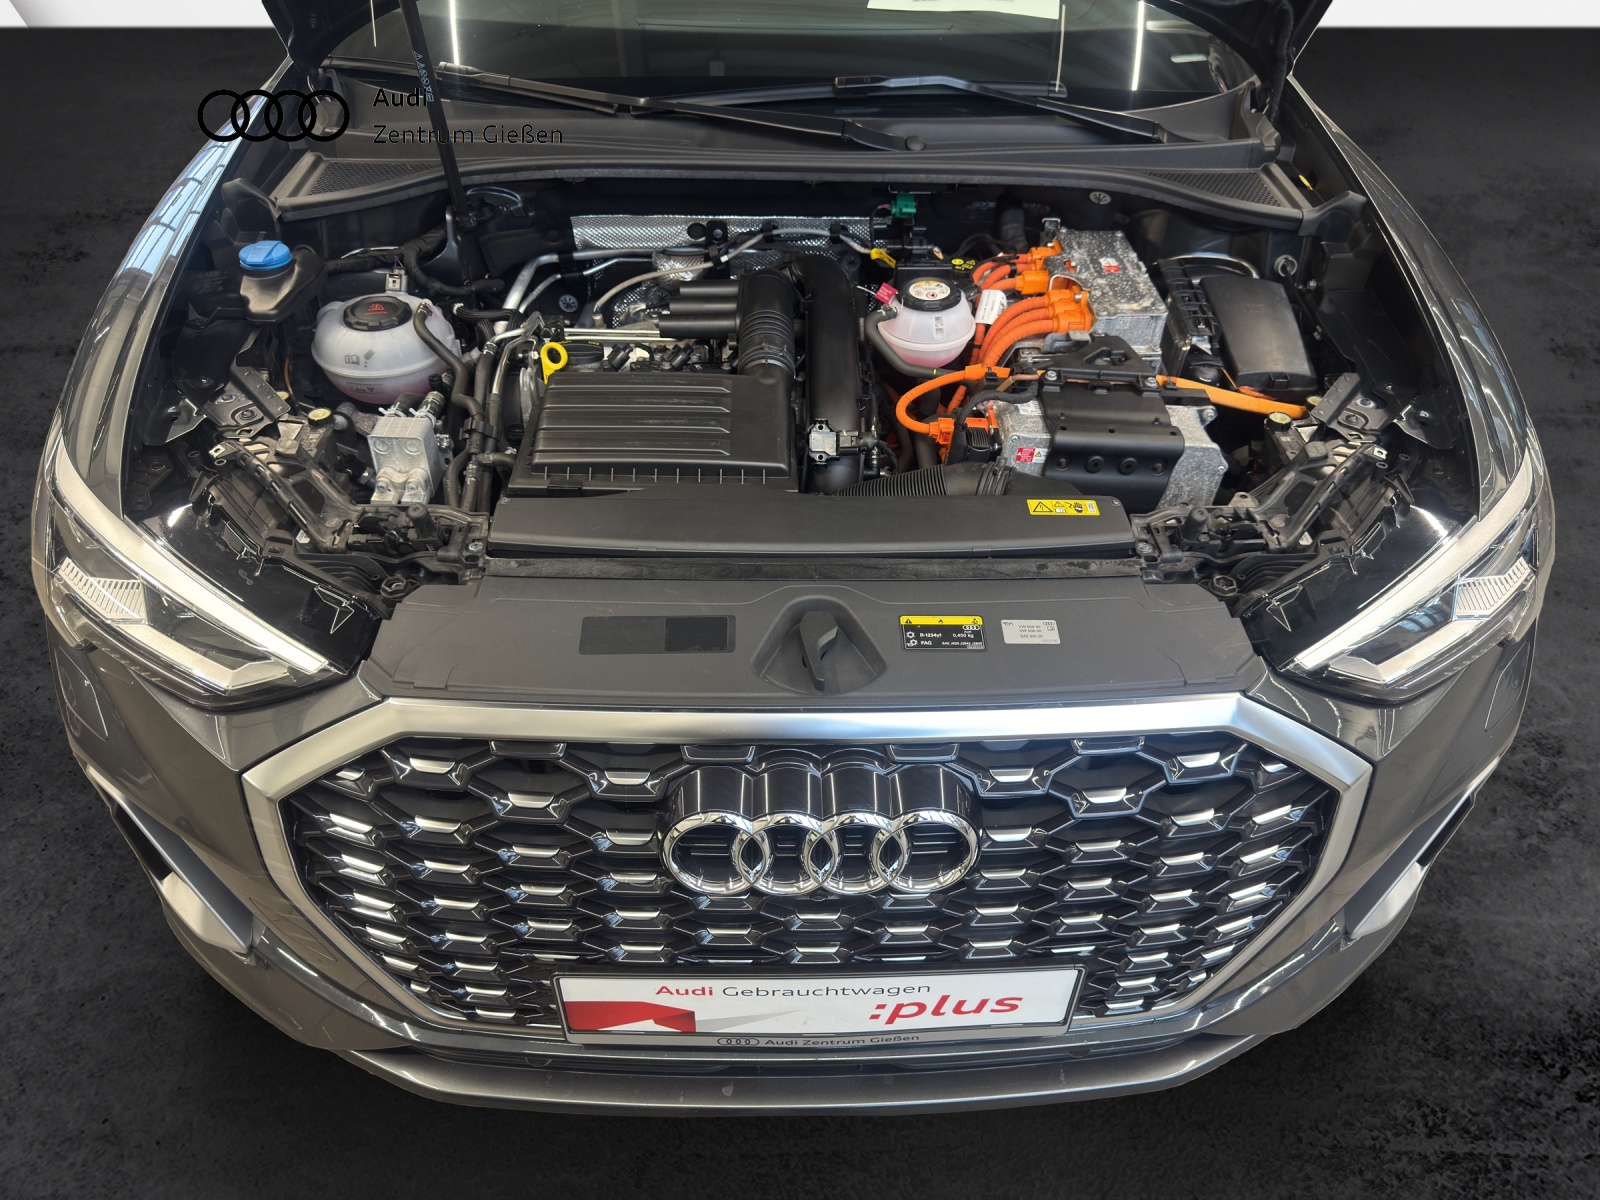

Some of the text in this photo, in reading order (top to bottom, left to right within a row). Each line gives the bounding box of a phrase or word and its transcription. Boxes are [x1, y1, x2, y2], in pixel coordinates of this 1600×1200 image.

[655, 983, 931, 998] Audi Gebrauchtwagen
[869, 994, 1024, 1025] :plus
[764, 1034, 920, 1047] Audi Zentrum Gießen
